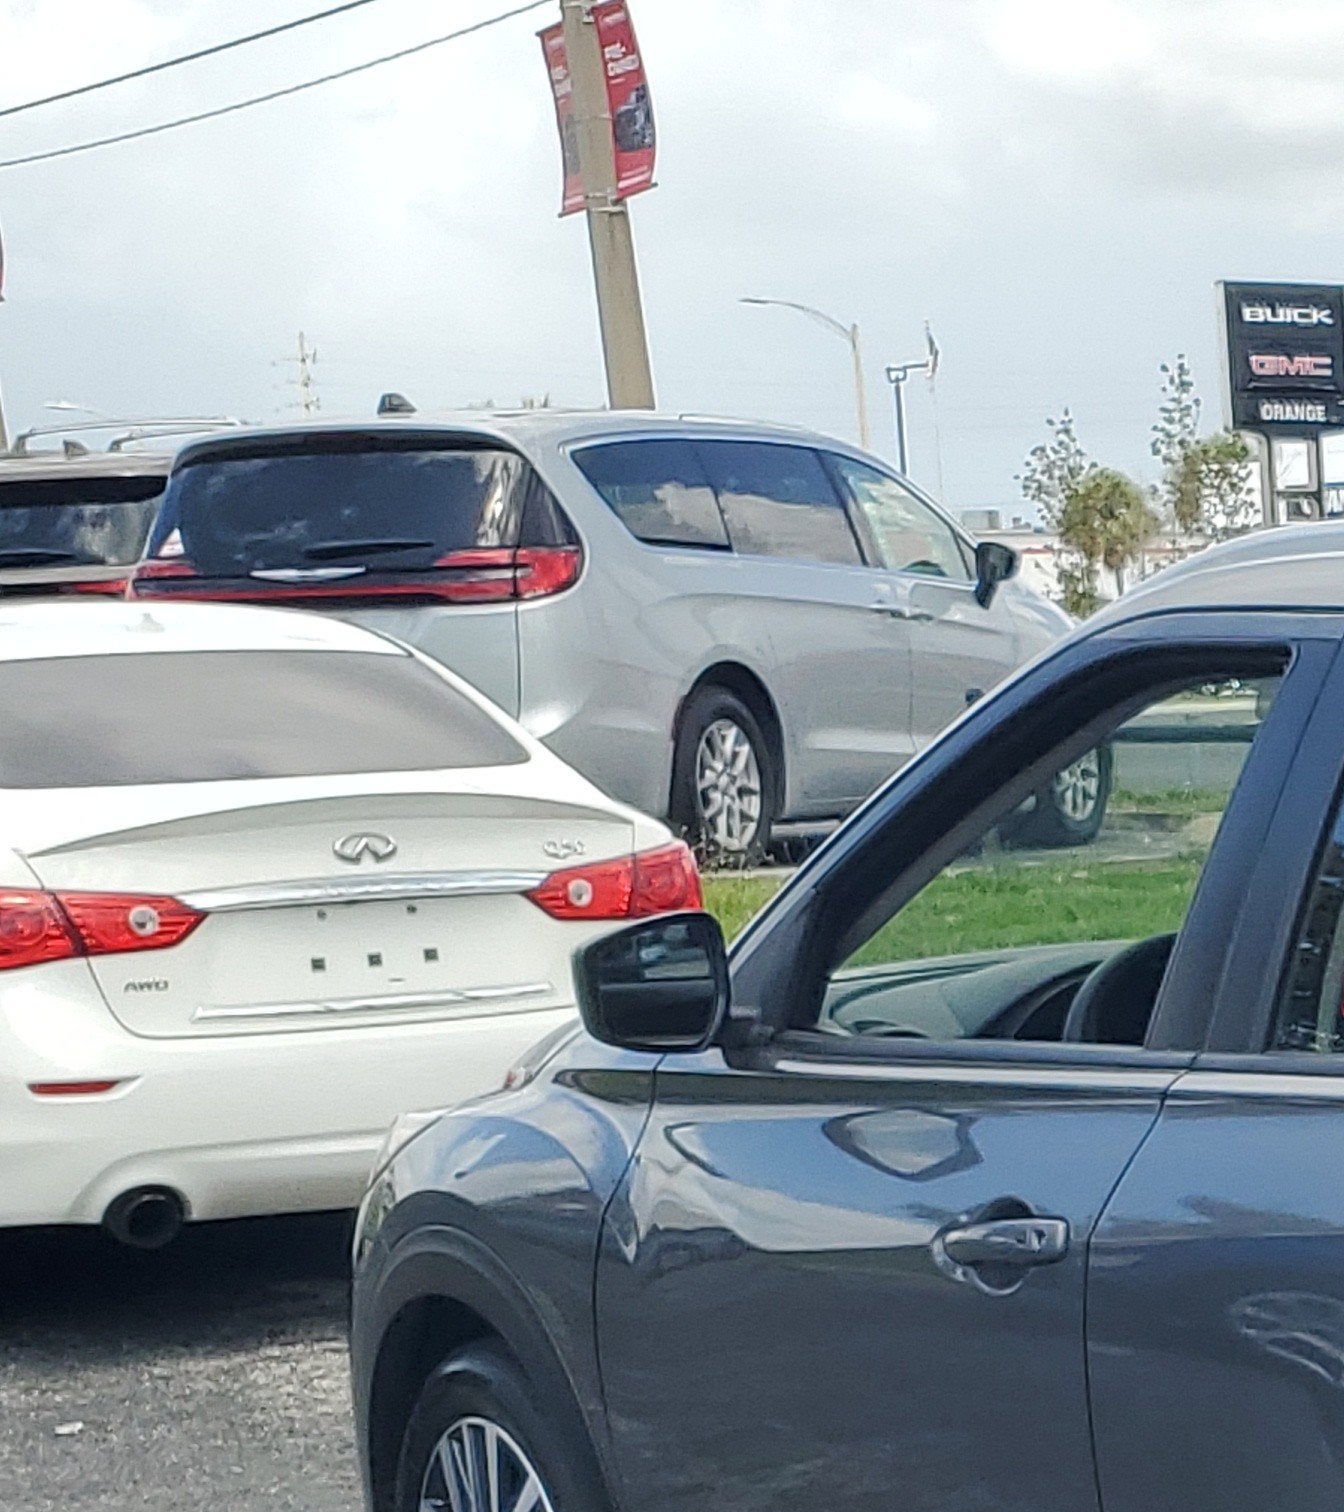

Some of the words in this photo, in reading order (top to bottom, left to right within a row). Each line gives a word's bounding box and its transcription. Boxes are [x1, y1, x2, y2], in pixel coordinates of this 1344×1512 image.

[1241, 306, 1335, 325] BUICK
[1248, 354, 1334, 376] GMC
[1259, 402, 1327, 422] ORANGE
